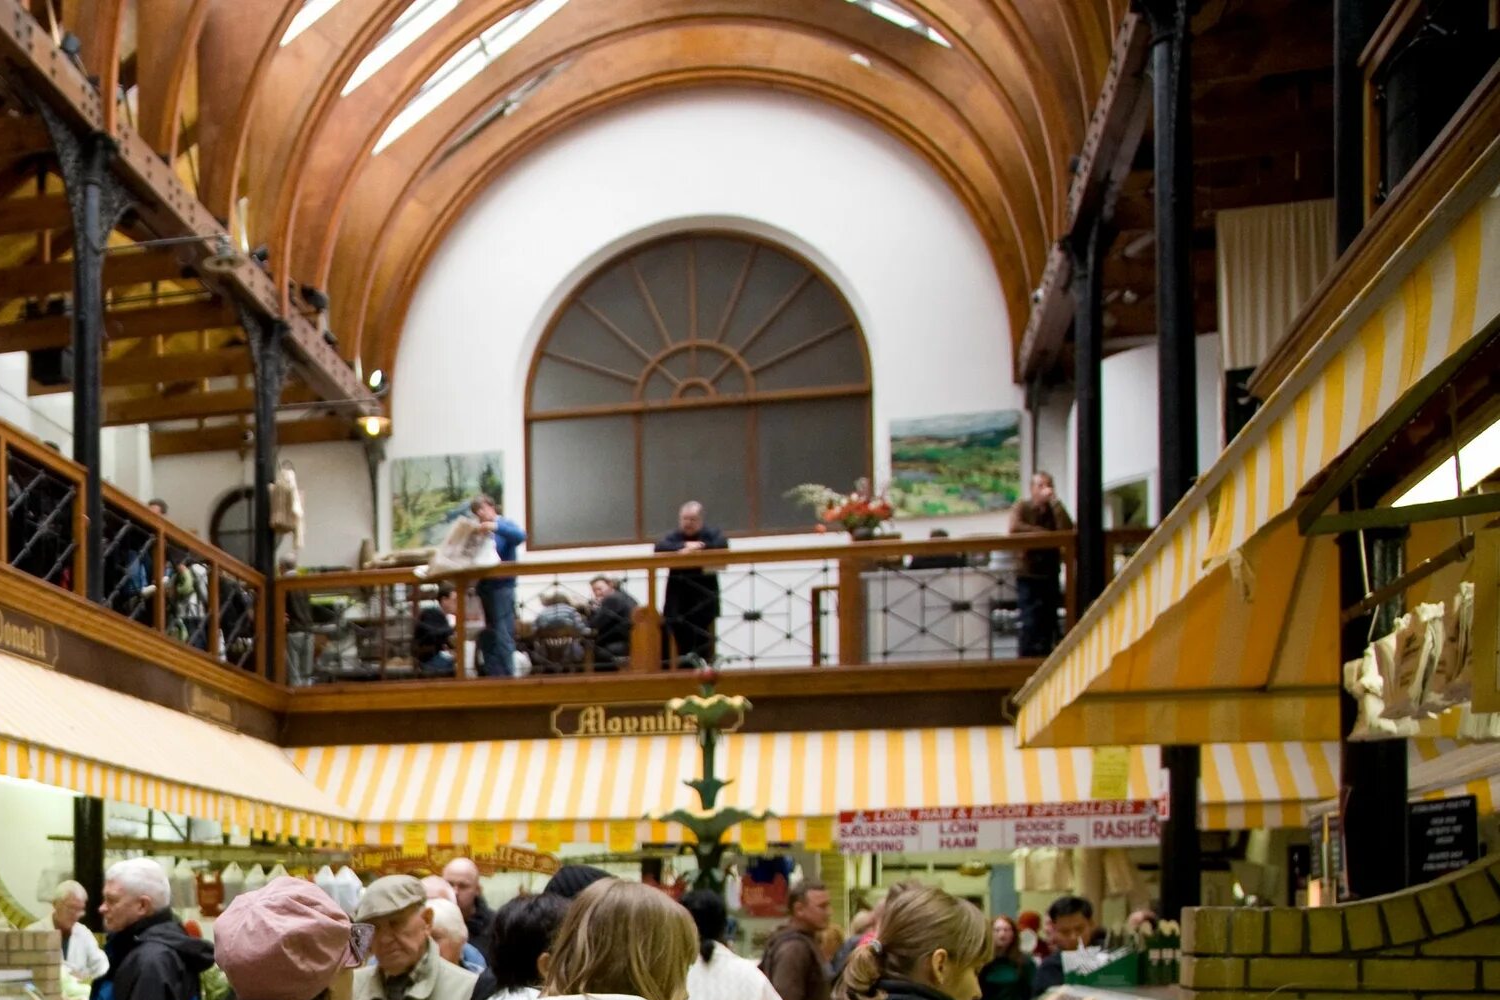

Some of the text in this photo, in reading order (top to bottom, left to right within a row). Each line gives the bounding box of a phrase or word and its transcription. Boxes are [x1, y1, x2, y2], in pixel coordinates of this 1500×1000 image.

[574, 704, 699, 734] Moyniha
[840, 823, 919, 842] SAUSAGES
[939, 821, 979, 839] LOIN
[840, 839, 904, 852] PUDDING
[939, 836, 977, 849] HAM
